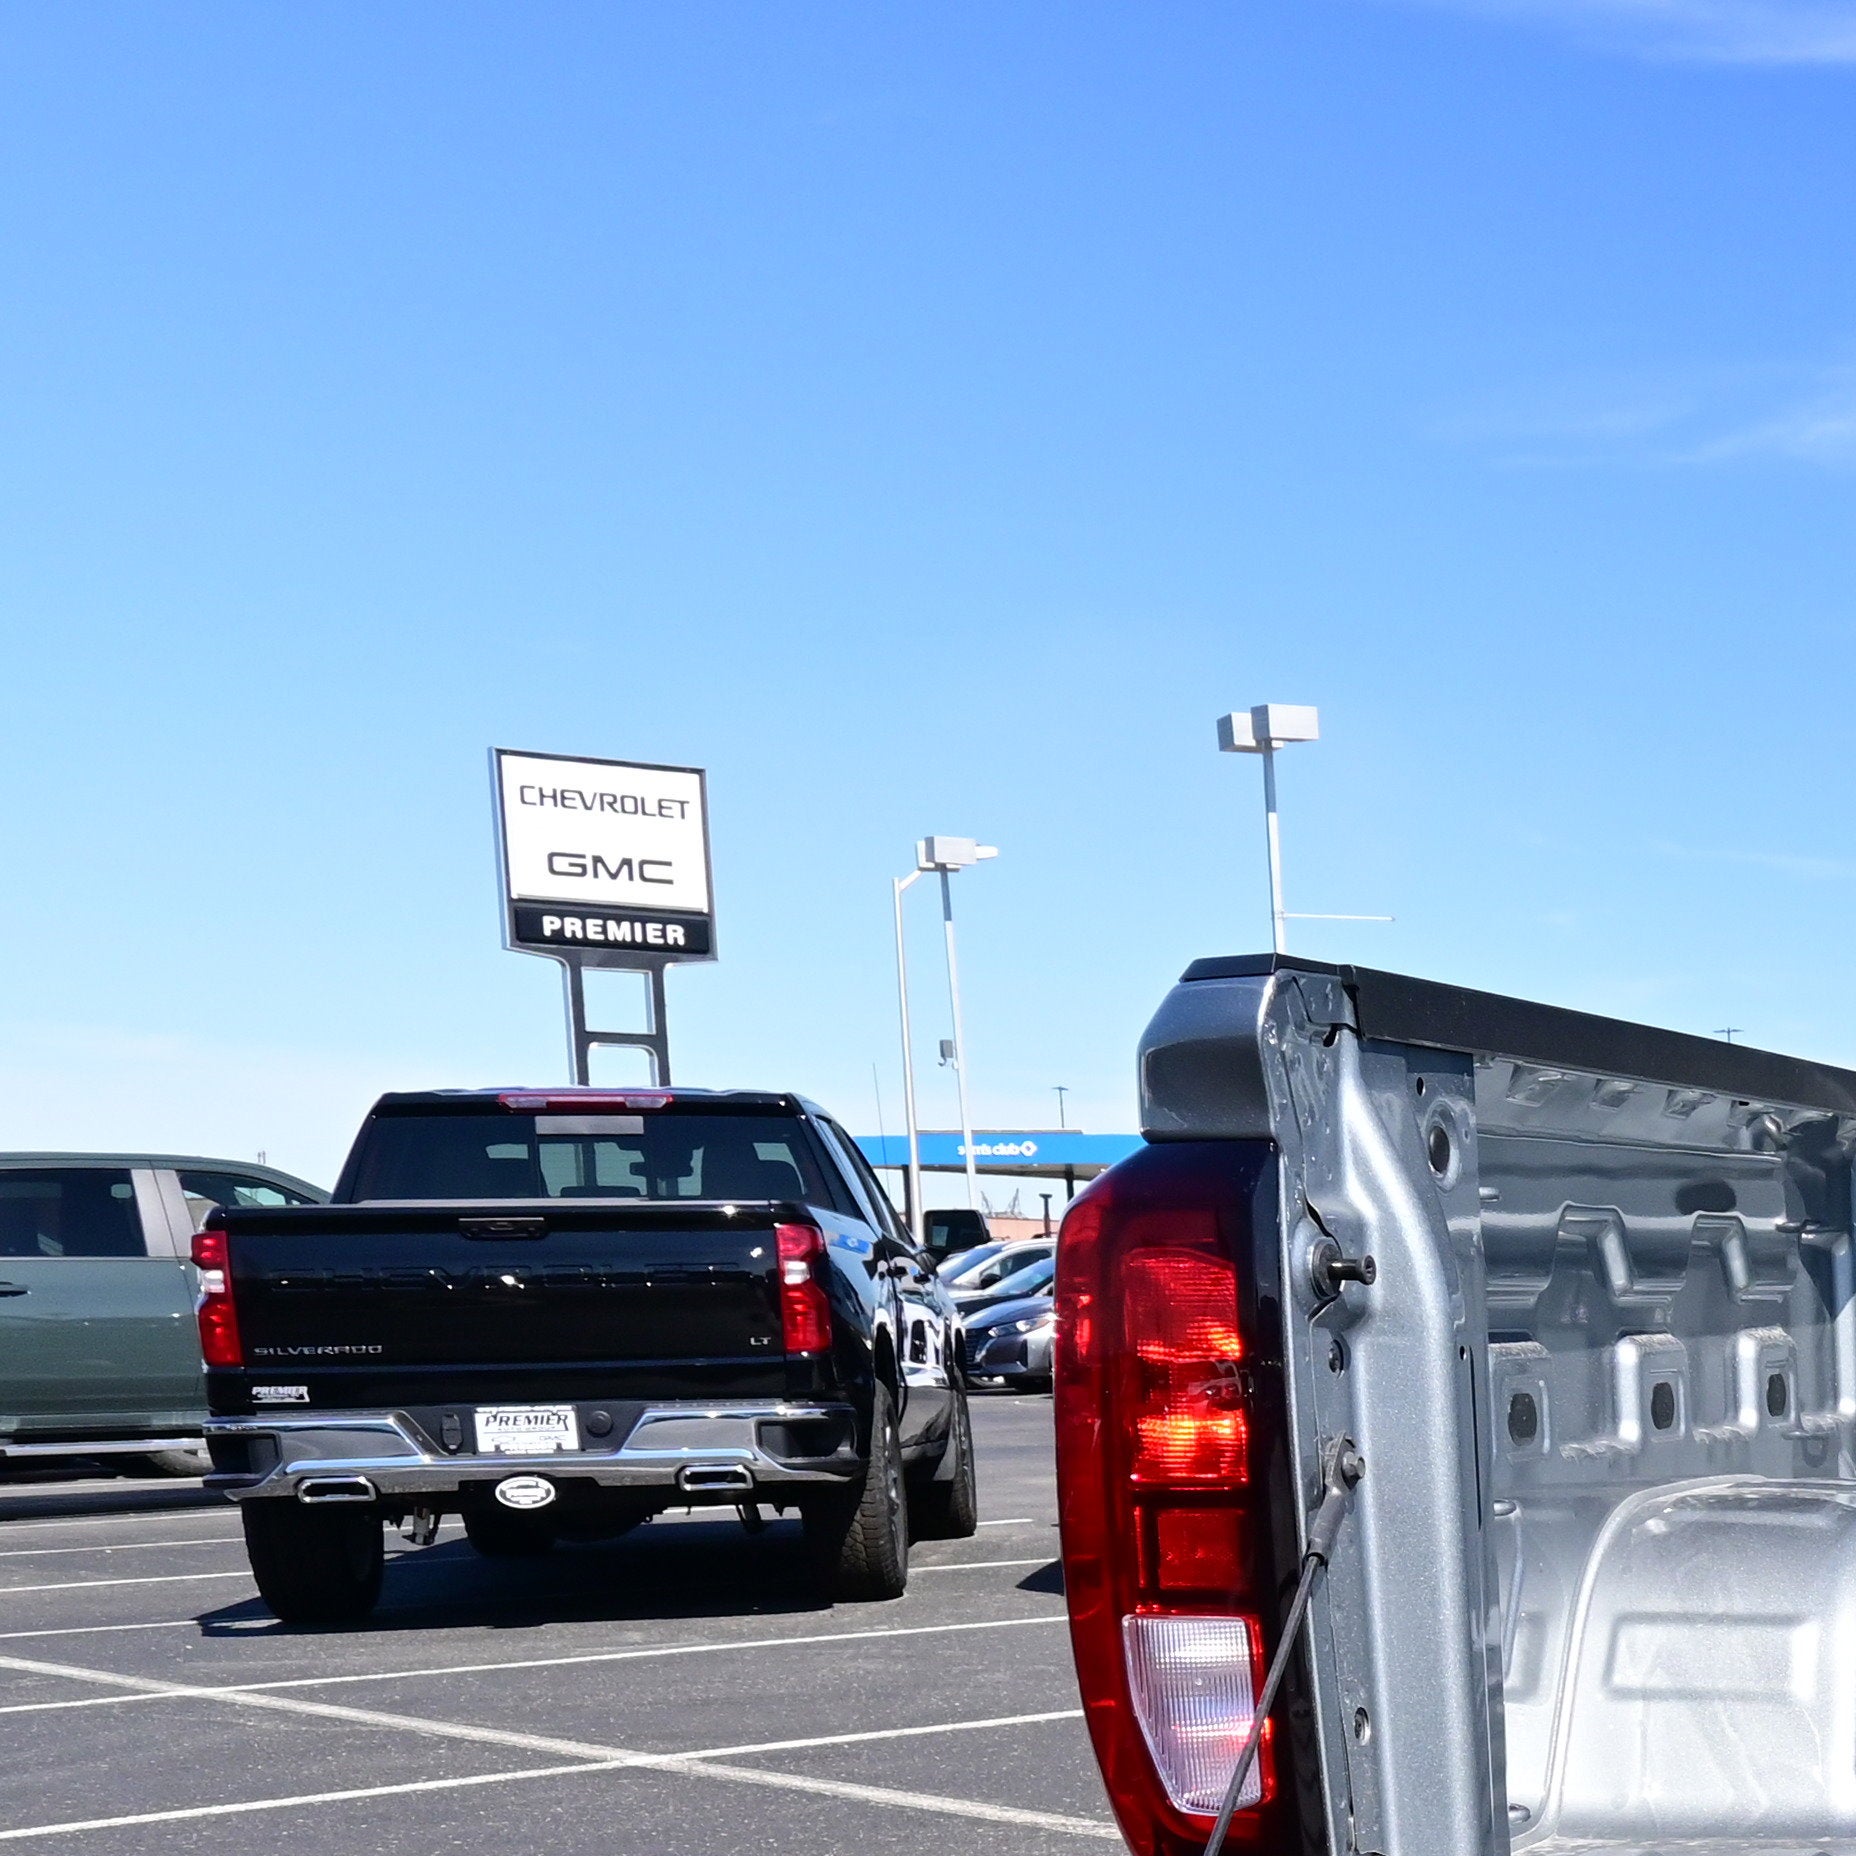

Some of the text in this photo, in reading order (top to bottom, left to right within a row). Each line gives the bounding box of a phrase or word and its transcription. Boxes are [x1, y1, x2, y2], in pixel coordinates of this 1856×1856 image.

[519, 784, 690, 820] CHEVROLET
[547, 851, 674, 885] GMC
[542, 915, 685, 946] PREMIER
[750, 1336, 771, 1345] LT
[254, 1345, 383, 1356] SILVERADO
[252, 1386, 309, 1401] PREMIER
[485, 1414, 569, 1431] PREMIER
